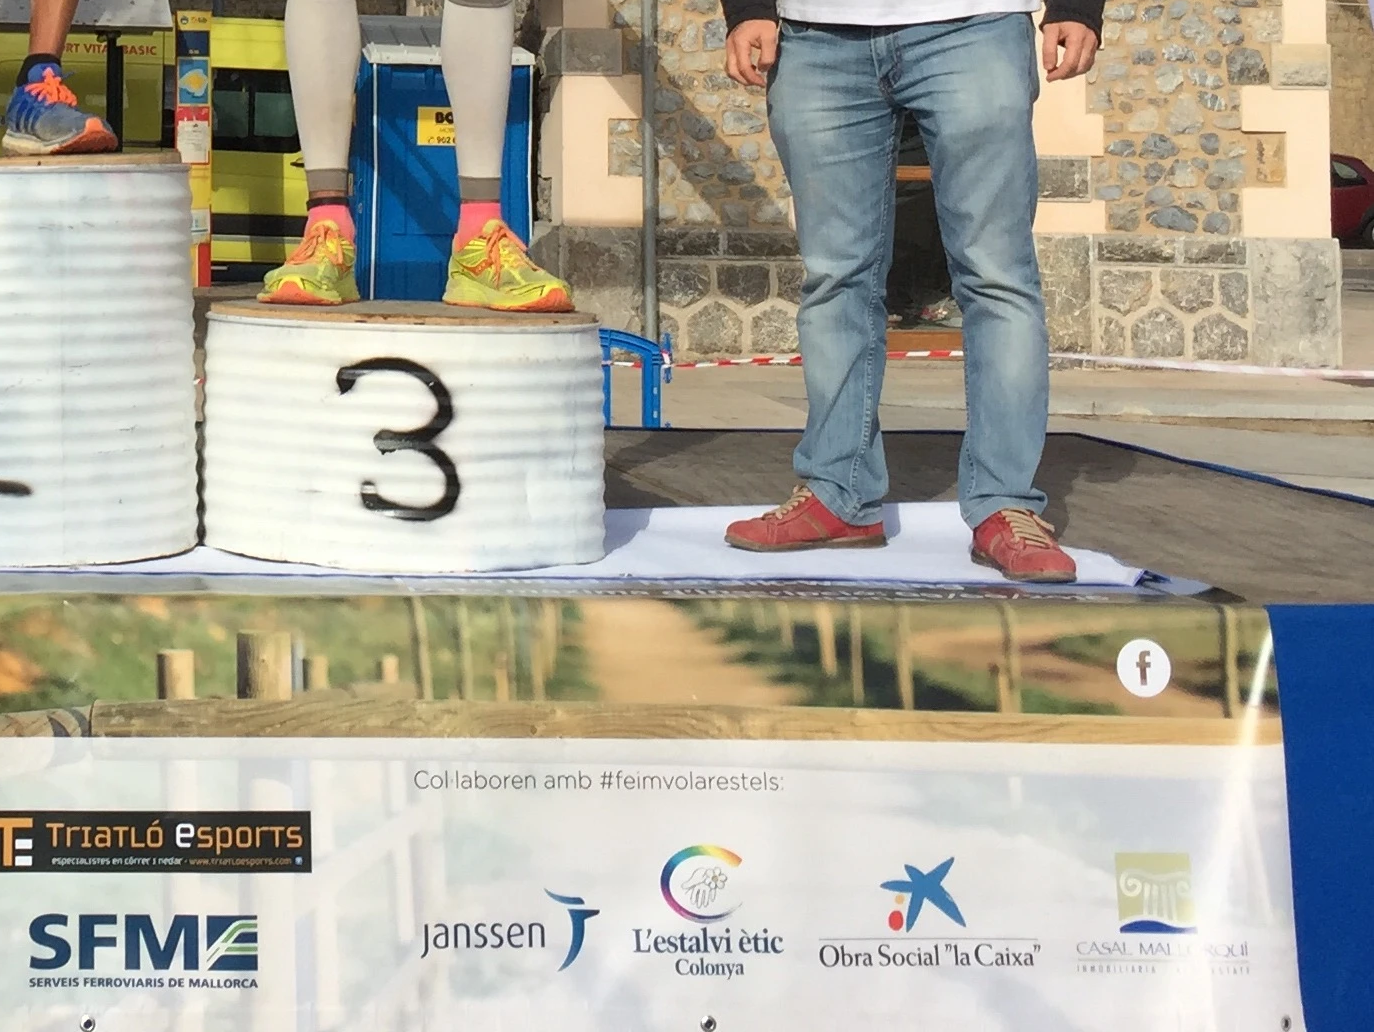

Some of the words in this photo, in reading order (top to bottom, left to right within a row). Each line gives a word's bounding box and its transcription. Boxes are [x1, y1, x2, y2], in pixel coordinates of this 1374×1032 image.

[335, 356, 462, 523] 3
[413, 770, 537, 791] Col·laboren
[543, 771, 592, 791] amb
[599, 770, 785, 792] #feimvolarestels:
[112, 857, 123, 866] en
[28, 913, 199, 971] SFM
[632, 927, 732, 955] L'estalvi
[738, 929, 785, 954] ètic
[1076, 941, 1133, 957] CASAL
[818, 944, 874, 968] Obra
[878, 943, 939, 967] Social
[675, 957, 745, 980] Colonya
[28, 977, 80, 989] SERVEIS
[83, 977, 165, 989] FERROVIARIS
[168, 978, 185, 989] DE
[188, 978, 259, 990] MALLORCA
